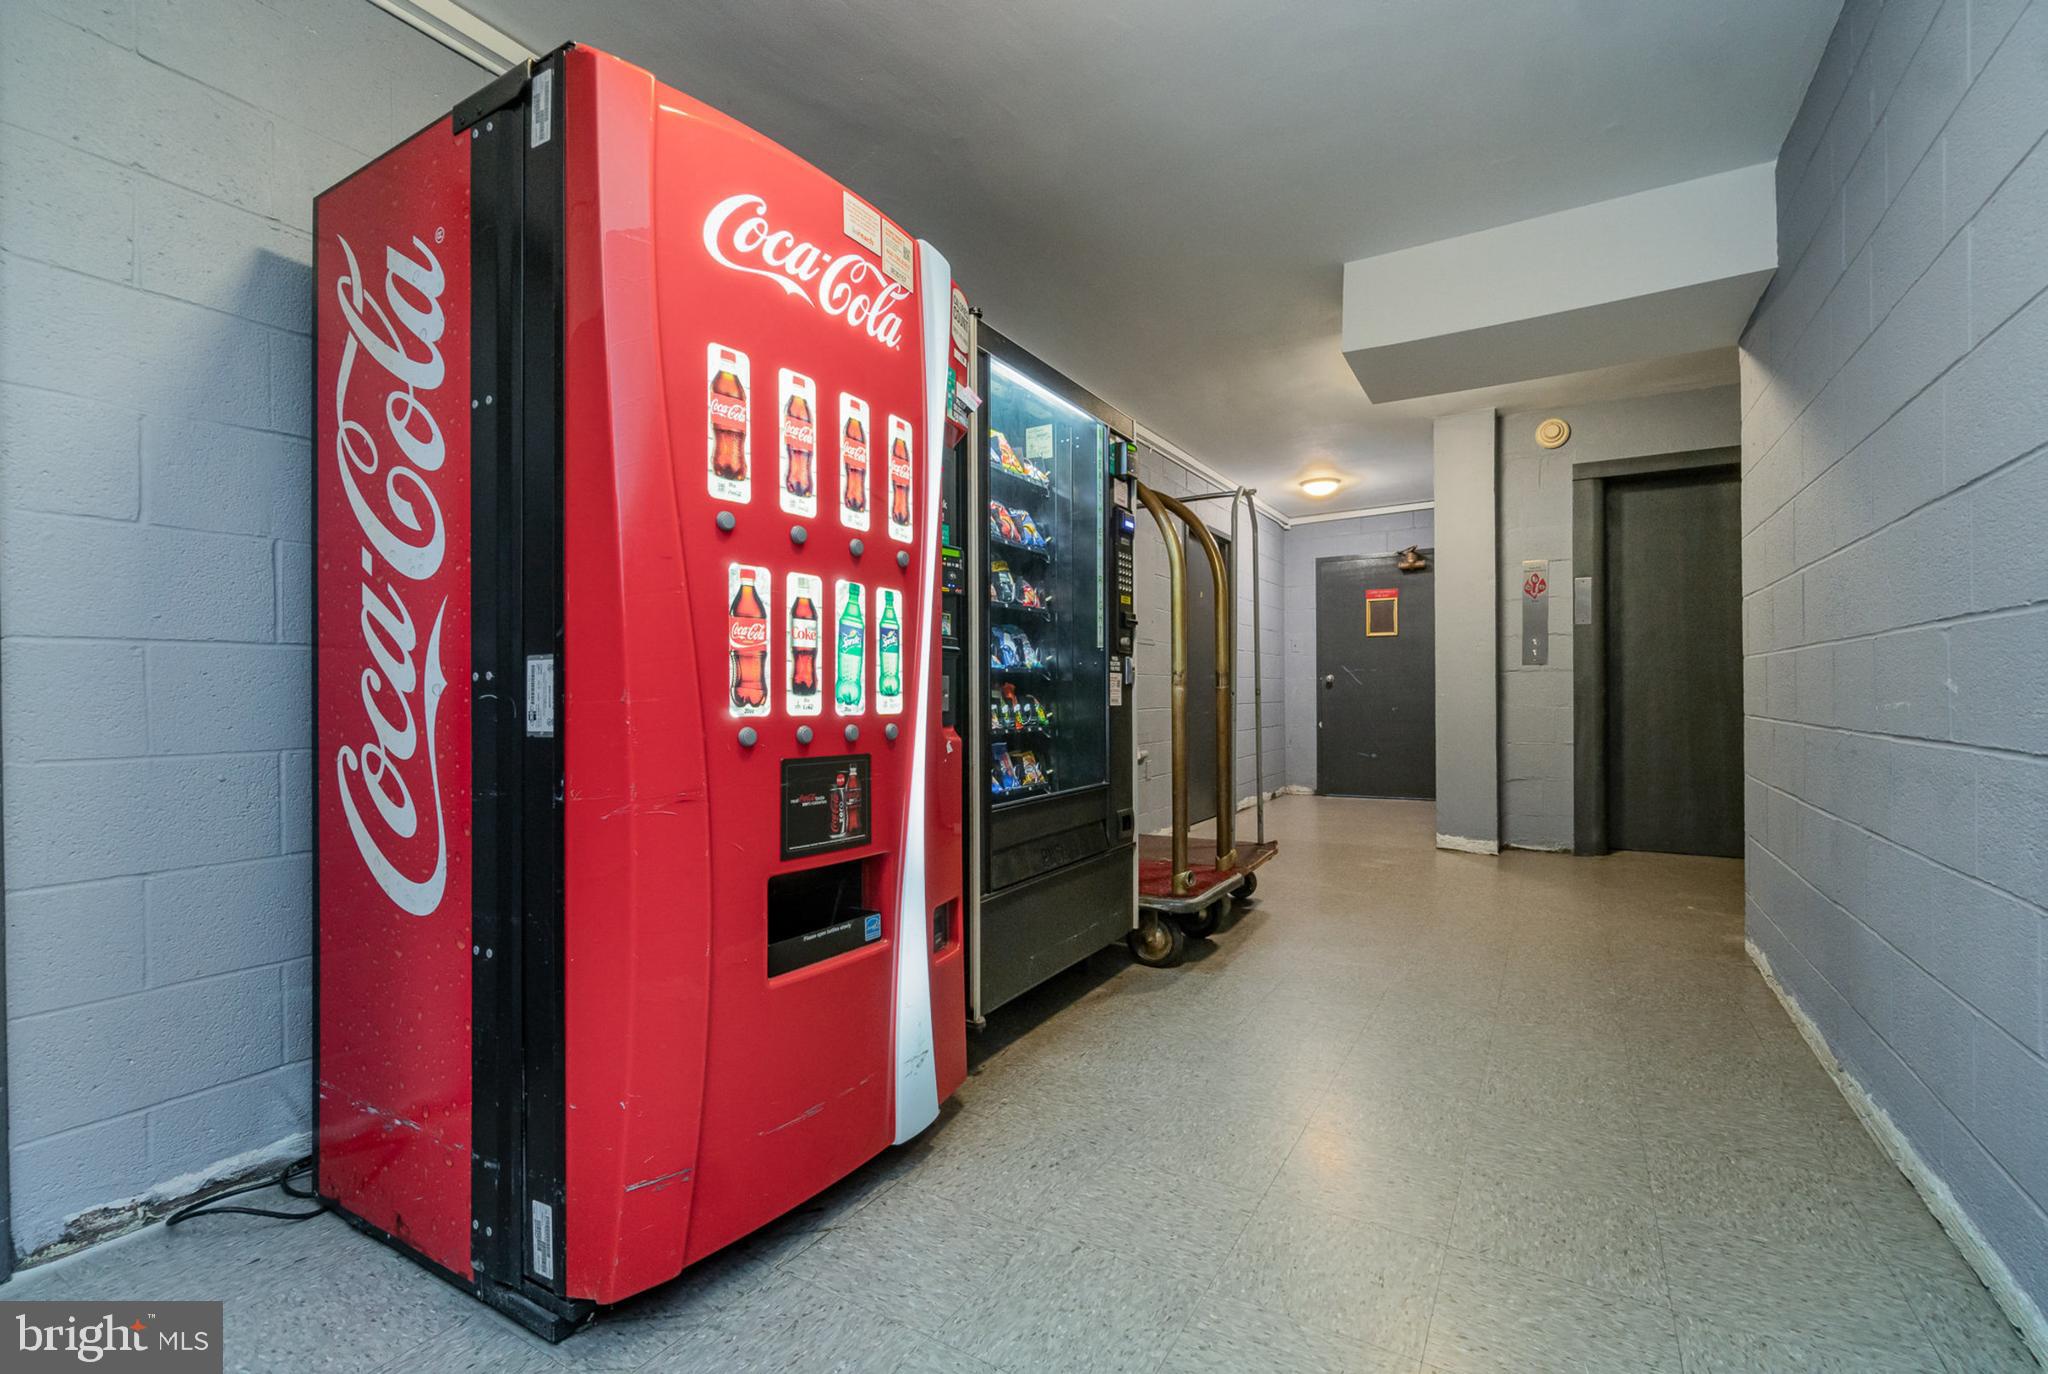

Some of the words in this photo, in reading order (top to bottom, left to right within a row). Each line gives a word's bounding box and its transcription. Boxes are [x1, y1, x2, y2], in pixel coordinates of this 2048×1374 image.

[702, 194, 911, 350] Coca-Cola
[336, 232, 449, 917] Coca-Cola
[791, 626, 817, 641] Coke
